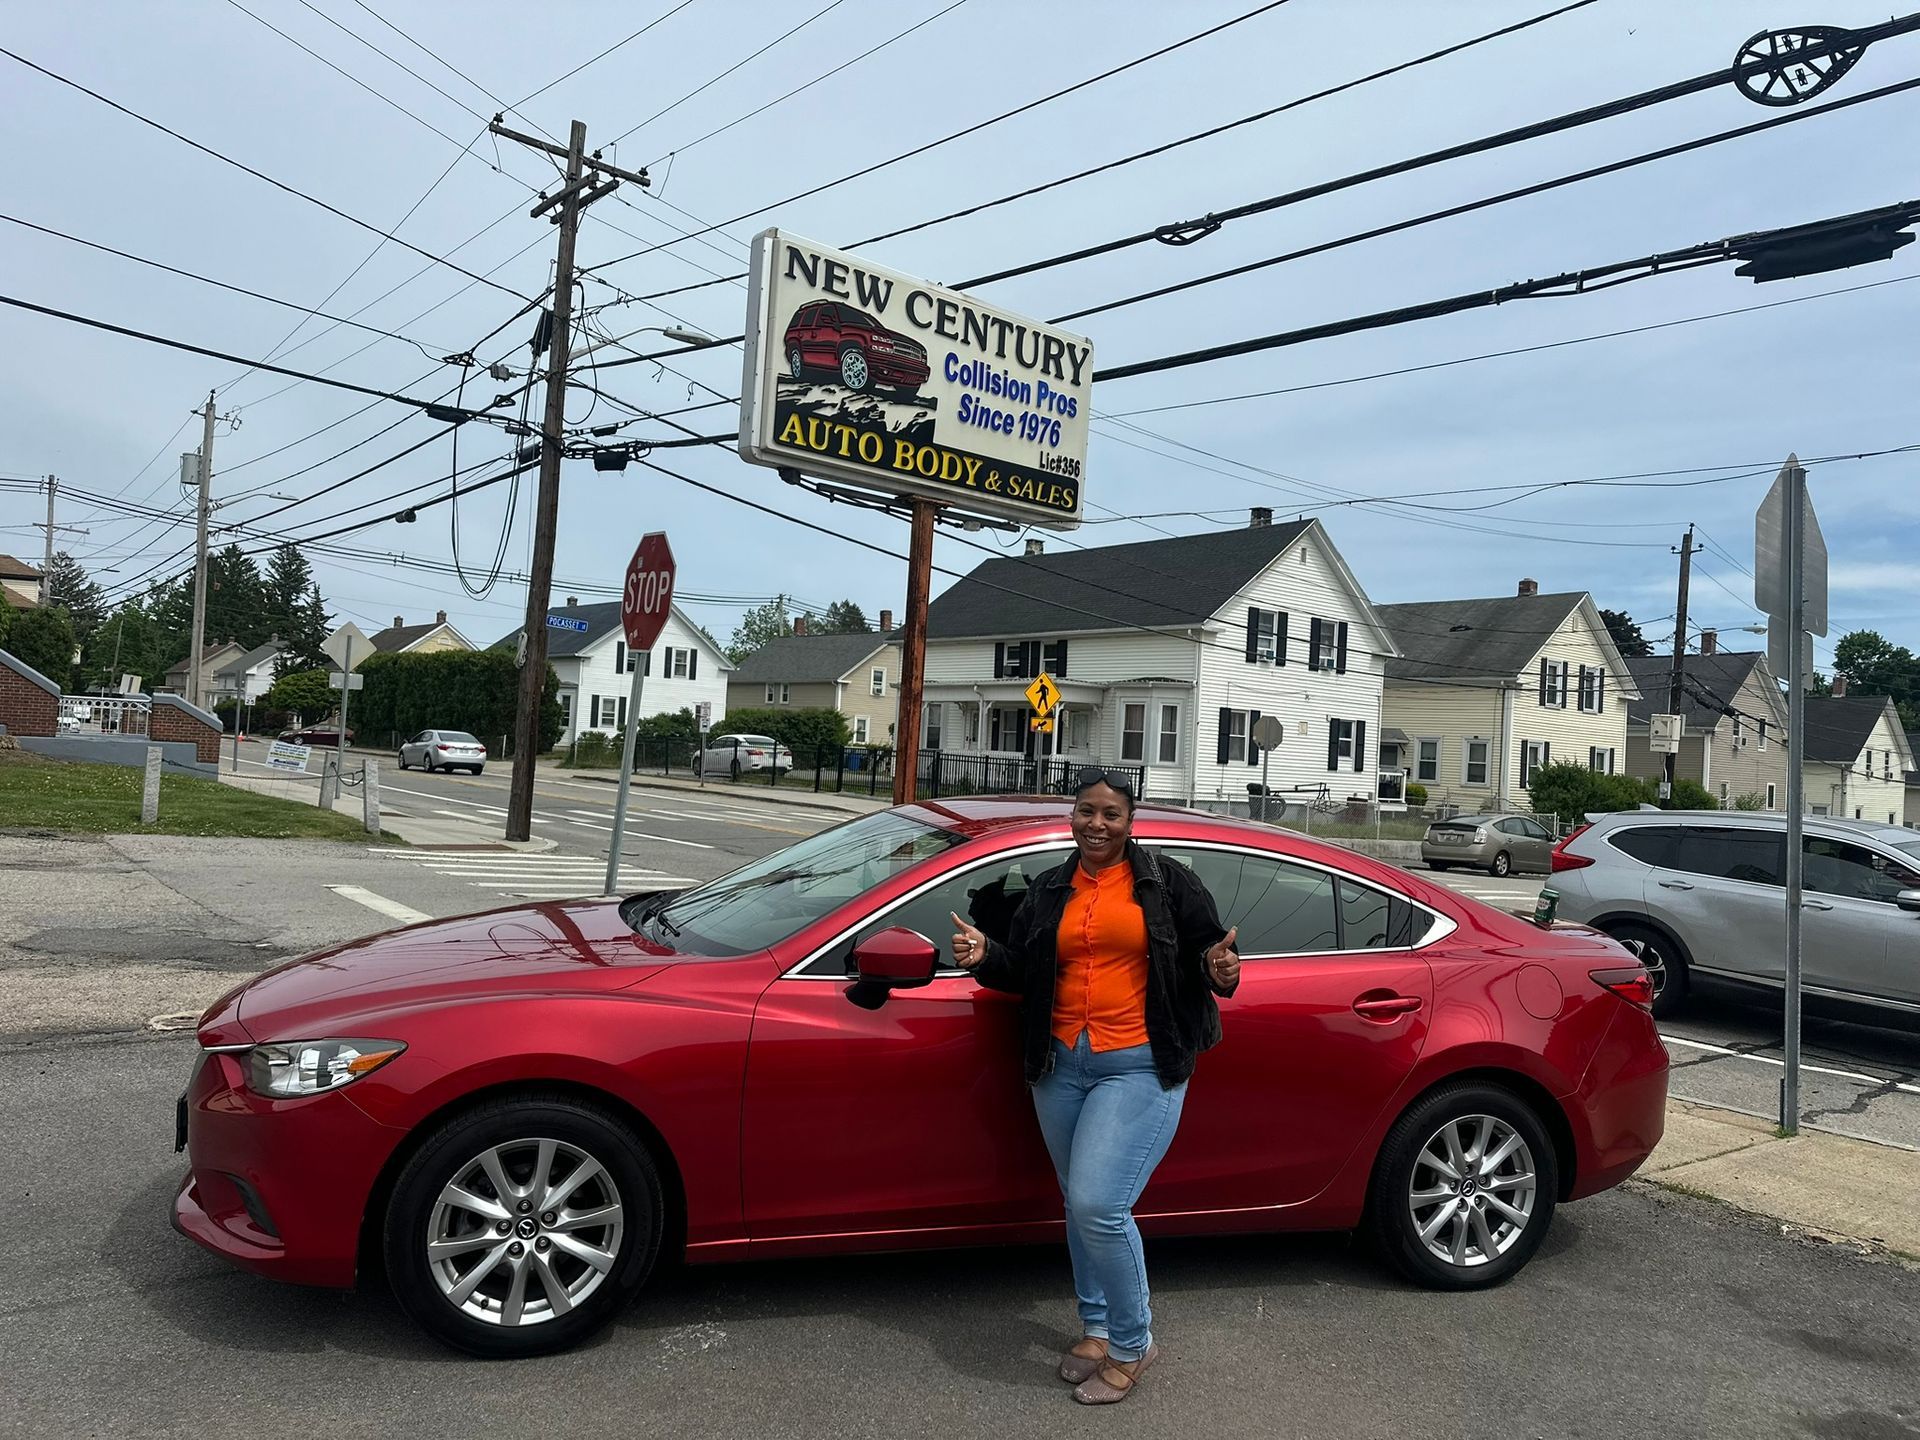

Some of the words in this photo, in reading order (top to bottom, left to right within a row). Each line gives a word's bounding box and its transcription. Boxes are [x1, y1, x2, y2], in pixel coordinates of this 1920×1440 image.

[784, 245, 894, 314] NEW
[905, 290, 1090, 387] CENTURY
[944, 352, 1031, 405] Collision
[1036, 380, 1077, 418] Pros
[958, 393, 1015, 435] Since
[1018, 411, 1062, 448] 1976
[779, 412, 884, 463] AUTO
[892, 439, 983, 487] BODY
[984, 470, 1003, 493] &
[1006, 475, 1075, 509] SALES
[1039, 450, 1081, 478] Lic#356
[625, 570, 670, 614] STOP
[549, 616, 579, 629] POCASSET
